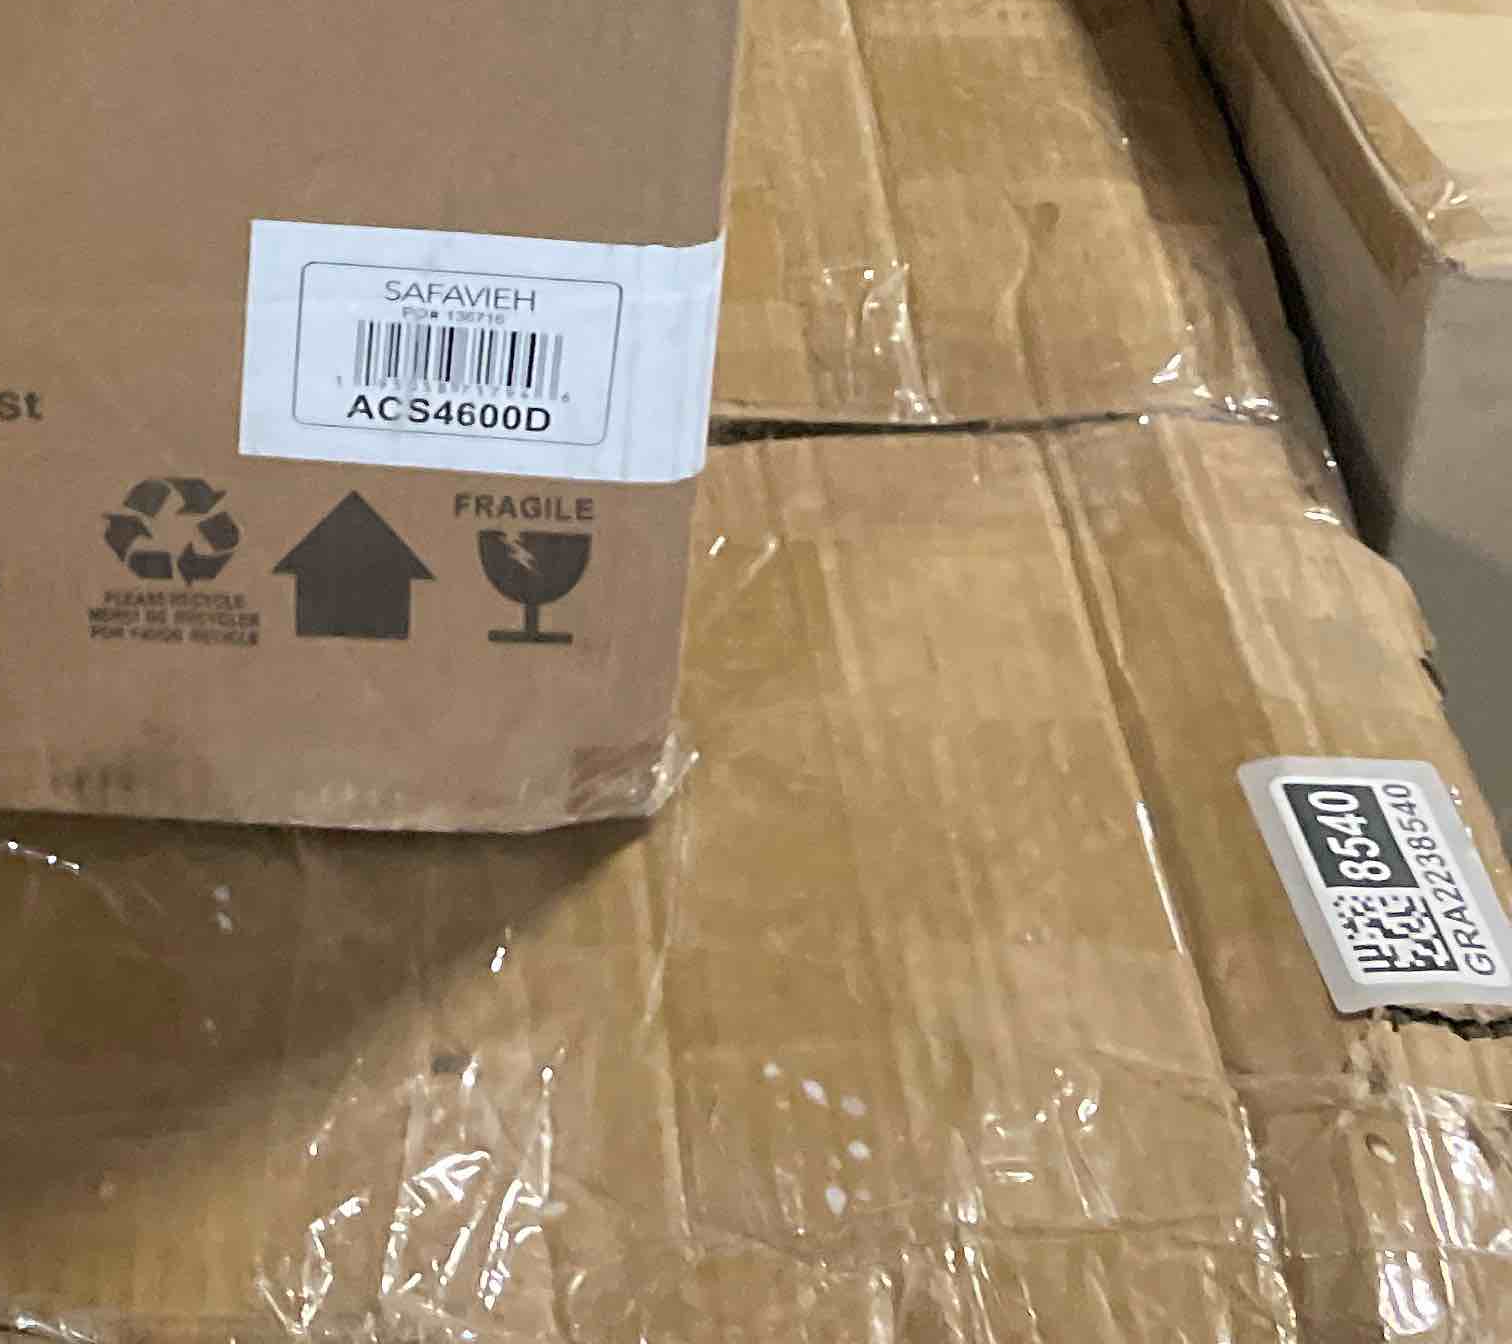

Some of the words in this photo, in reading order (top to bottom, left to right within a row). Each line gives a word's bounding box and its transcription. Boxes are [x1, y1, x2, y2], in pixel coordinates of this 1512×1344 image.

[385, 280, 536, 312] SAFAVIEH
[346, 394, 551, 433] ACS4600D
[453, 492, 597, 521] FRAGILE
[1307, 790, 1392, 883] 8540
[1382, 783, 1497, 976] GRA2238540
